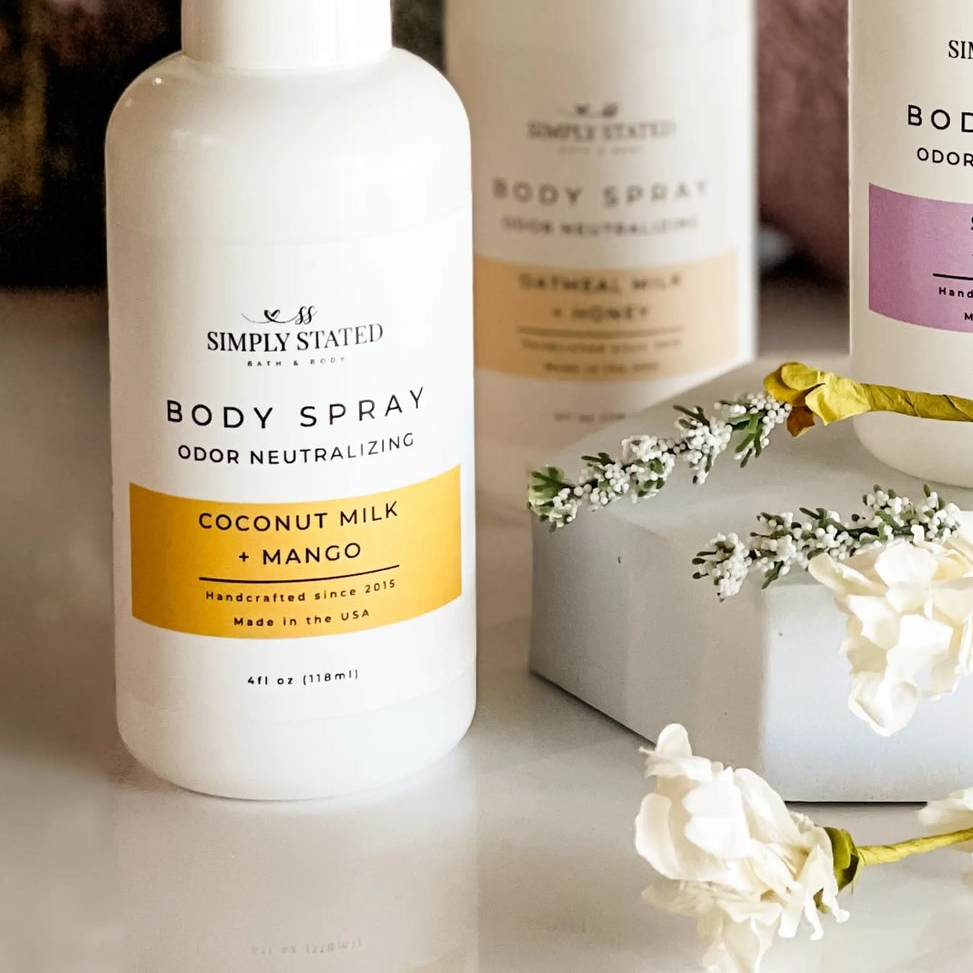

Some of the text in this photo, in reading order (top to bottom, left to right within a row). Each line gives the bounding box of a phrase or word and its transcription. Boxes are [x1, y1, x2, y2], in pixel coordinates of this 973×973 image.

[917, 147, 973, 167] ODOR
[492, 177, 710, 208] BODY SPRAY
[207, 323, 384, 352] SIMPLY STATED
[310, 356, 345, 365] BODY
[167, 387, 423, 429] BODY SPRAY
[178, 433, 413, 464] ODOR NEUTRALIZING
[199, 501, 397, 531] COCONUT MILK
[239, 543, 360, 565] + MANGO
[206, 579, 395, 602] Handcrafted since 2015
[234, 609, 369, 626] Made in the USA
[248, 676, 268, 685] 4fl
[303, 669, 358, 685] (118ml)
